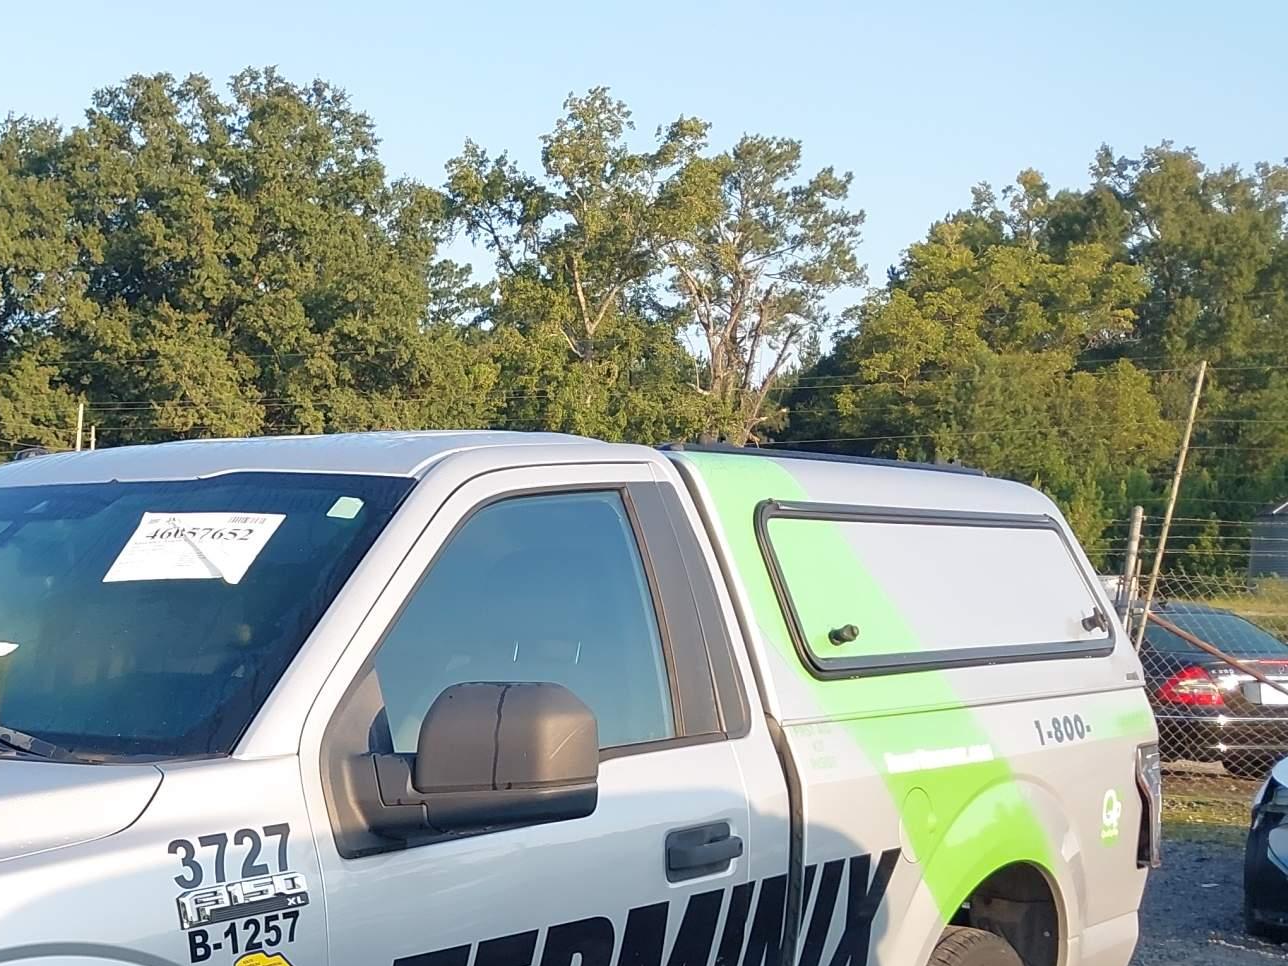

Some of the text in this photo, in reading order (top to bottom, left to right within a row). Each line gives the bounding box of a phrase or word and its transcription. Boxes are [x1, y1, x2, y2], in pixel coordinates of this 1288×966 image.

[1034, 714, 1091, 746] 1-800-
[168, 823, 291, 889] 3727
[287, 896, 306, 906] XL
[188, 910, 300, 963] B-1257
